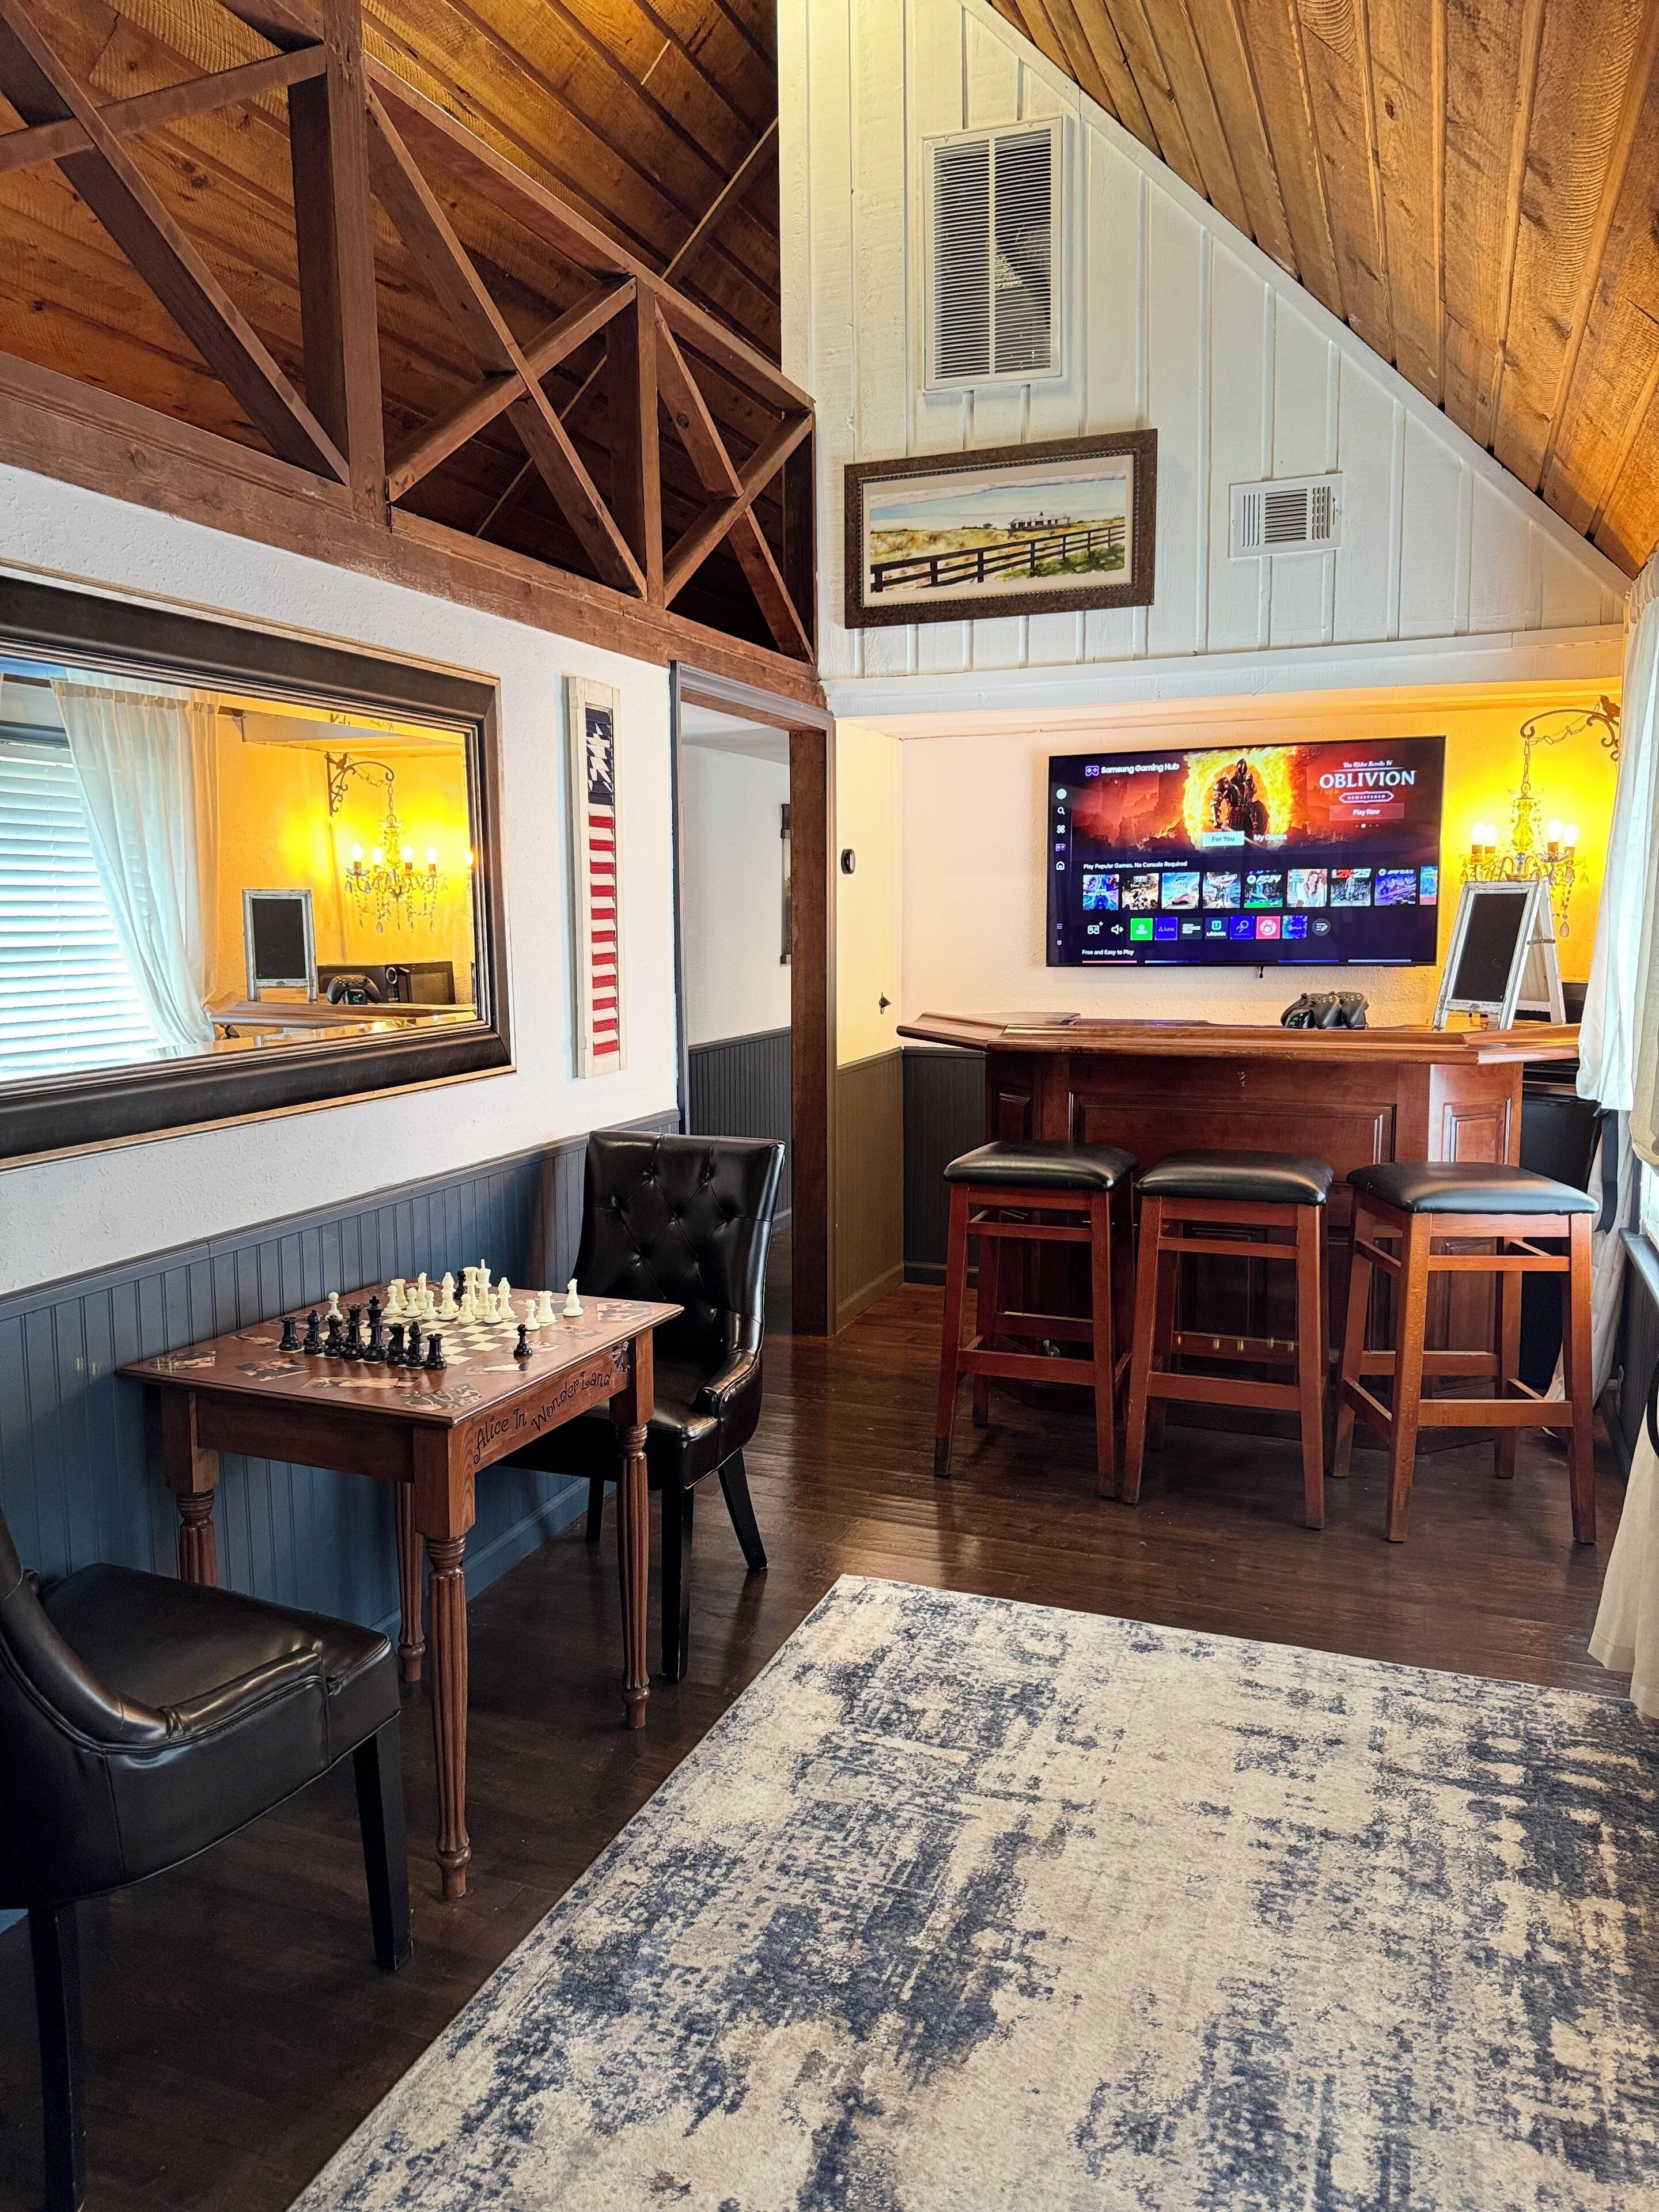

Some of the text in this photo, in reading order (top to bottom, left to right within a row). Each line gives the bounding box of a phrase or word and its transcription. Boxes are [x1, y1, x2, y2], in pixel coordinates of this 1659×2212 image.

[1101, 762, 1180, 774] Samsung Gaming Hub
[1319, 770, 1416, 789] OBLIVION
[1253, 834, 1264, 842] My
[1336, 868, 1372, 878] 2K25
[474, 1415, 509, 1464] Alice
[513, 1408, 527, 1430] In
